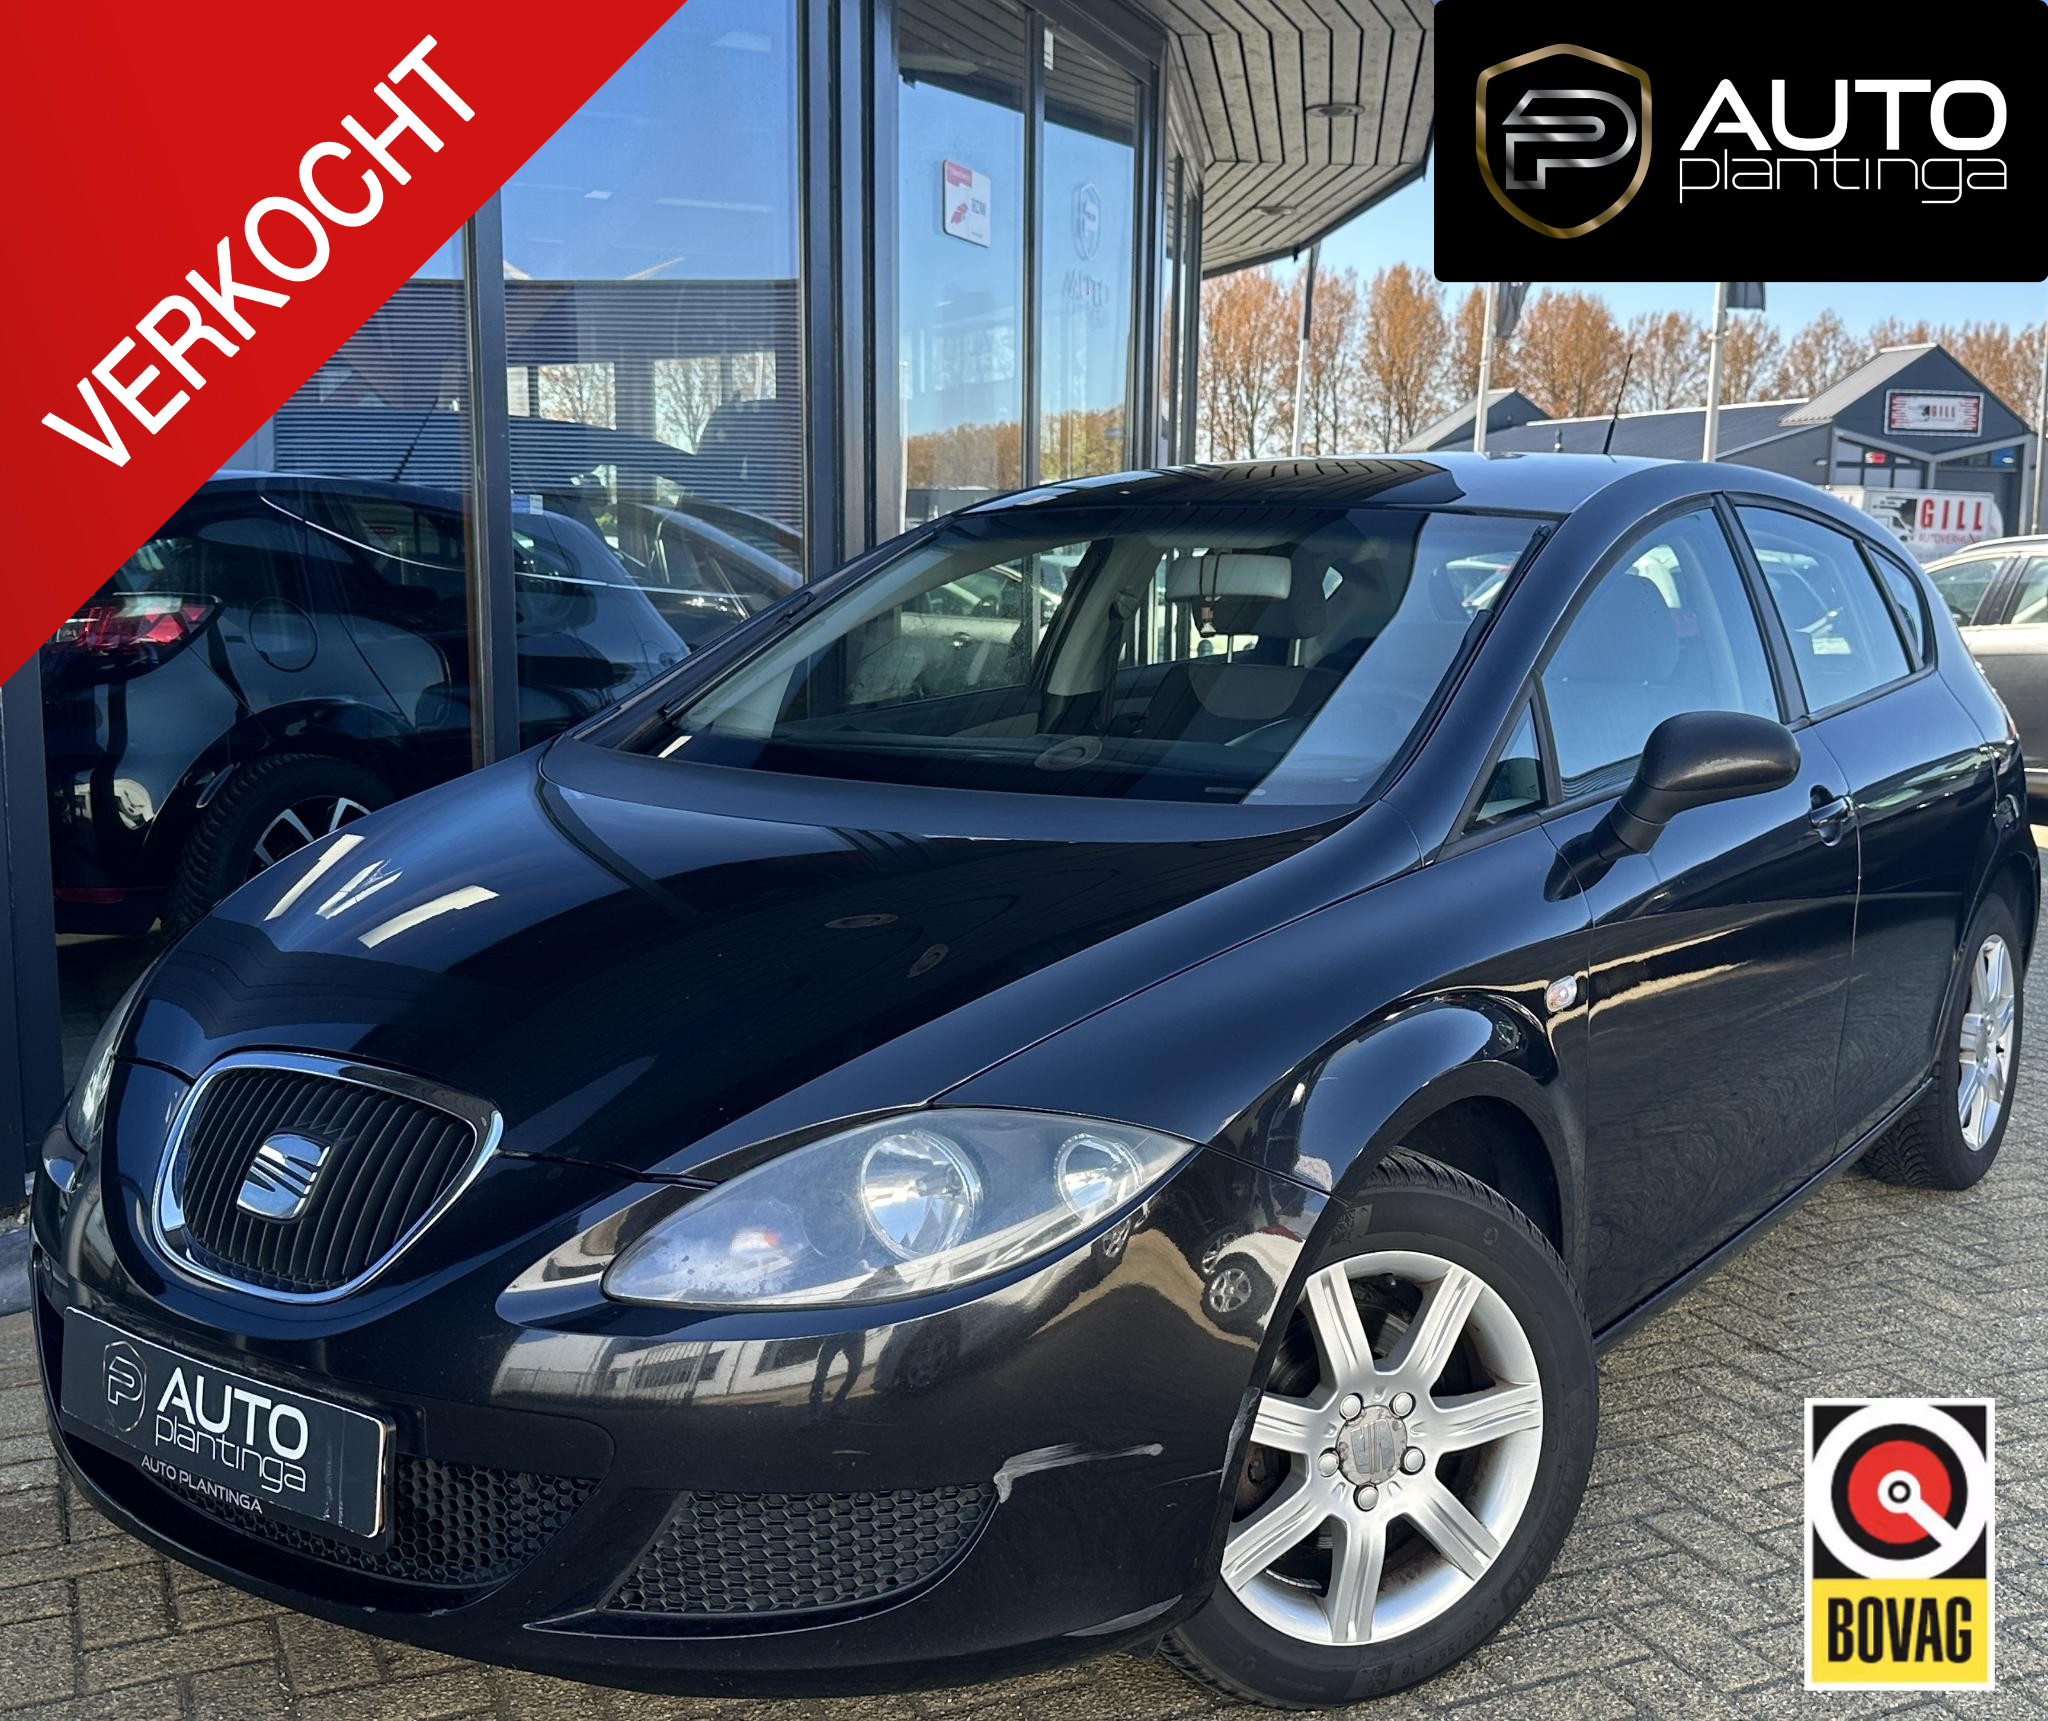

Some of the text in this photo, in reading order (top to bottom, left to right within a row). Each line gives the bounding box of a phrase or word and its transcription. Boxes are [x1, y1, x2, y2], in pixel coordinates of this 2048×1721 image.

[1931, 405, 1956, 418] GILL
[1921, 499, 1982, 530] GILL
[157, 1367, 308, 1460] AUTO
[155, 1414, 306, 1493] plantinga
[141, 1455, 263, 1514] AUTO PLANTINGA
